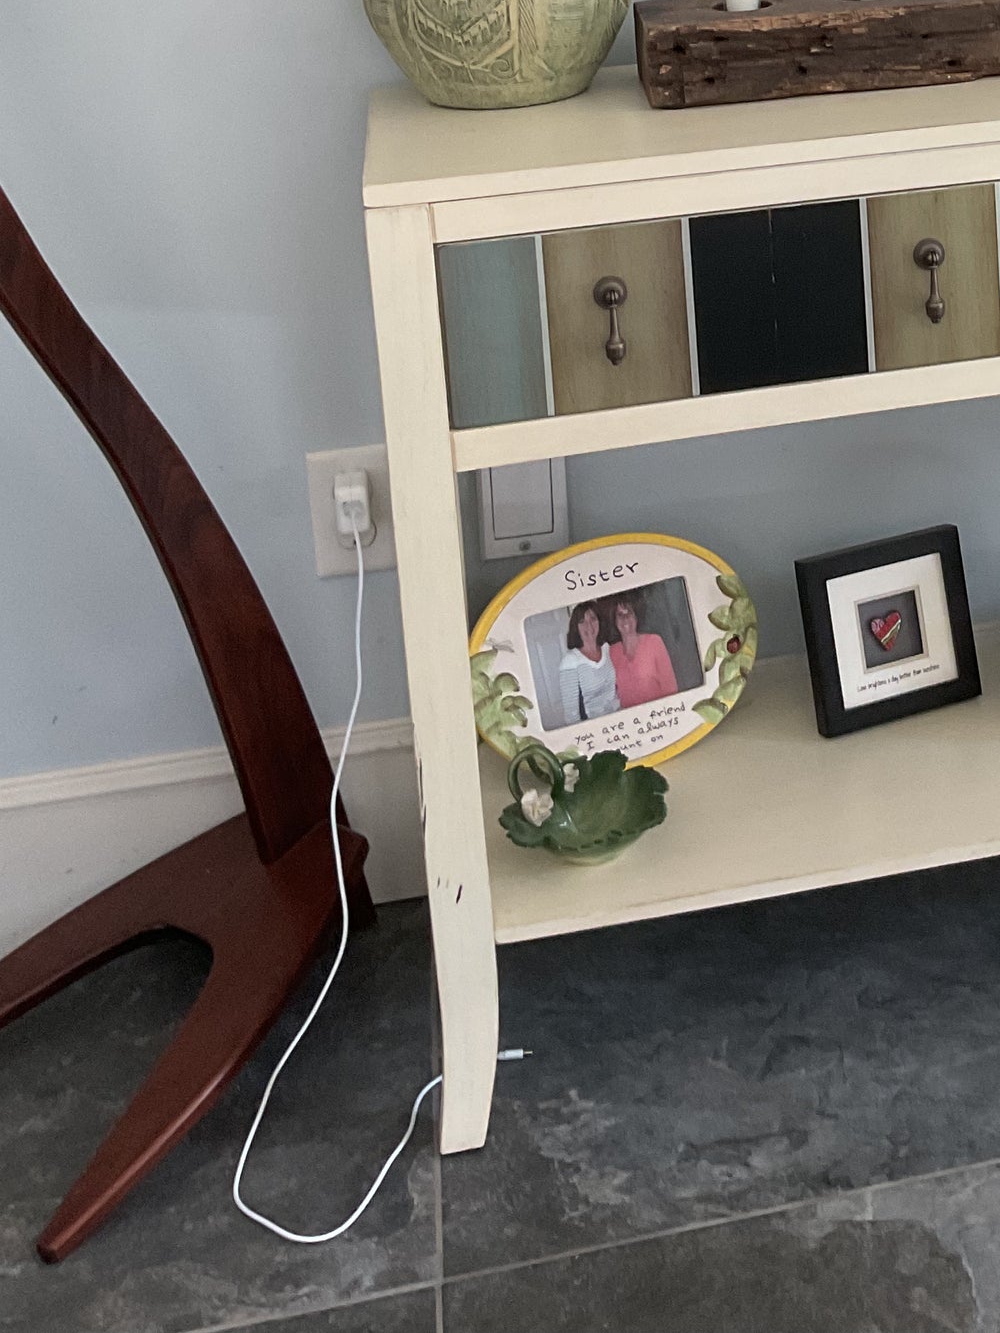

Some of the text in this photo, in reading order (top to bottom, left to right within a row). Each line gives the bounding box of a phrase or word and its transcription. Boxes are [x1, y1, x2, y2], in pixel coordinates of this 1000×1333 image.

[564, 562, 639, 591] Sister
[575, 701, 686, 745] you are a friend
[586, 716, 679, 751] I can always
[650, 734, 664, 743] on
